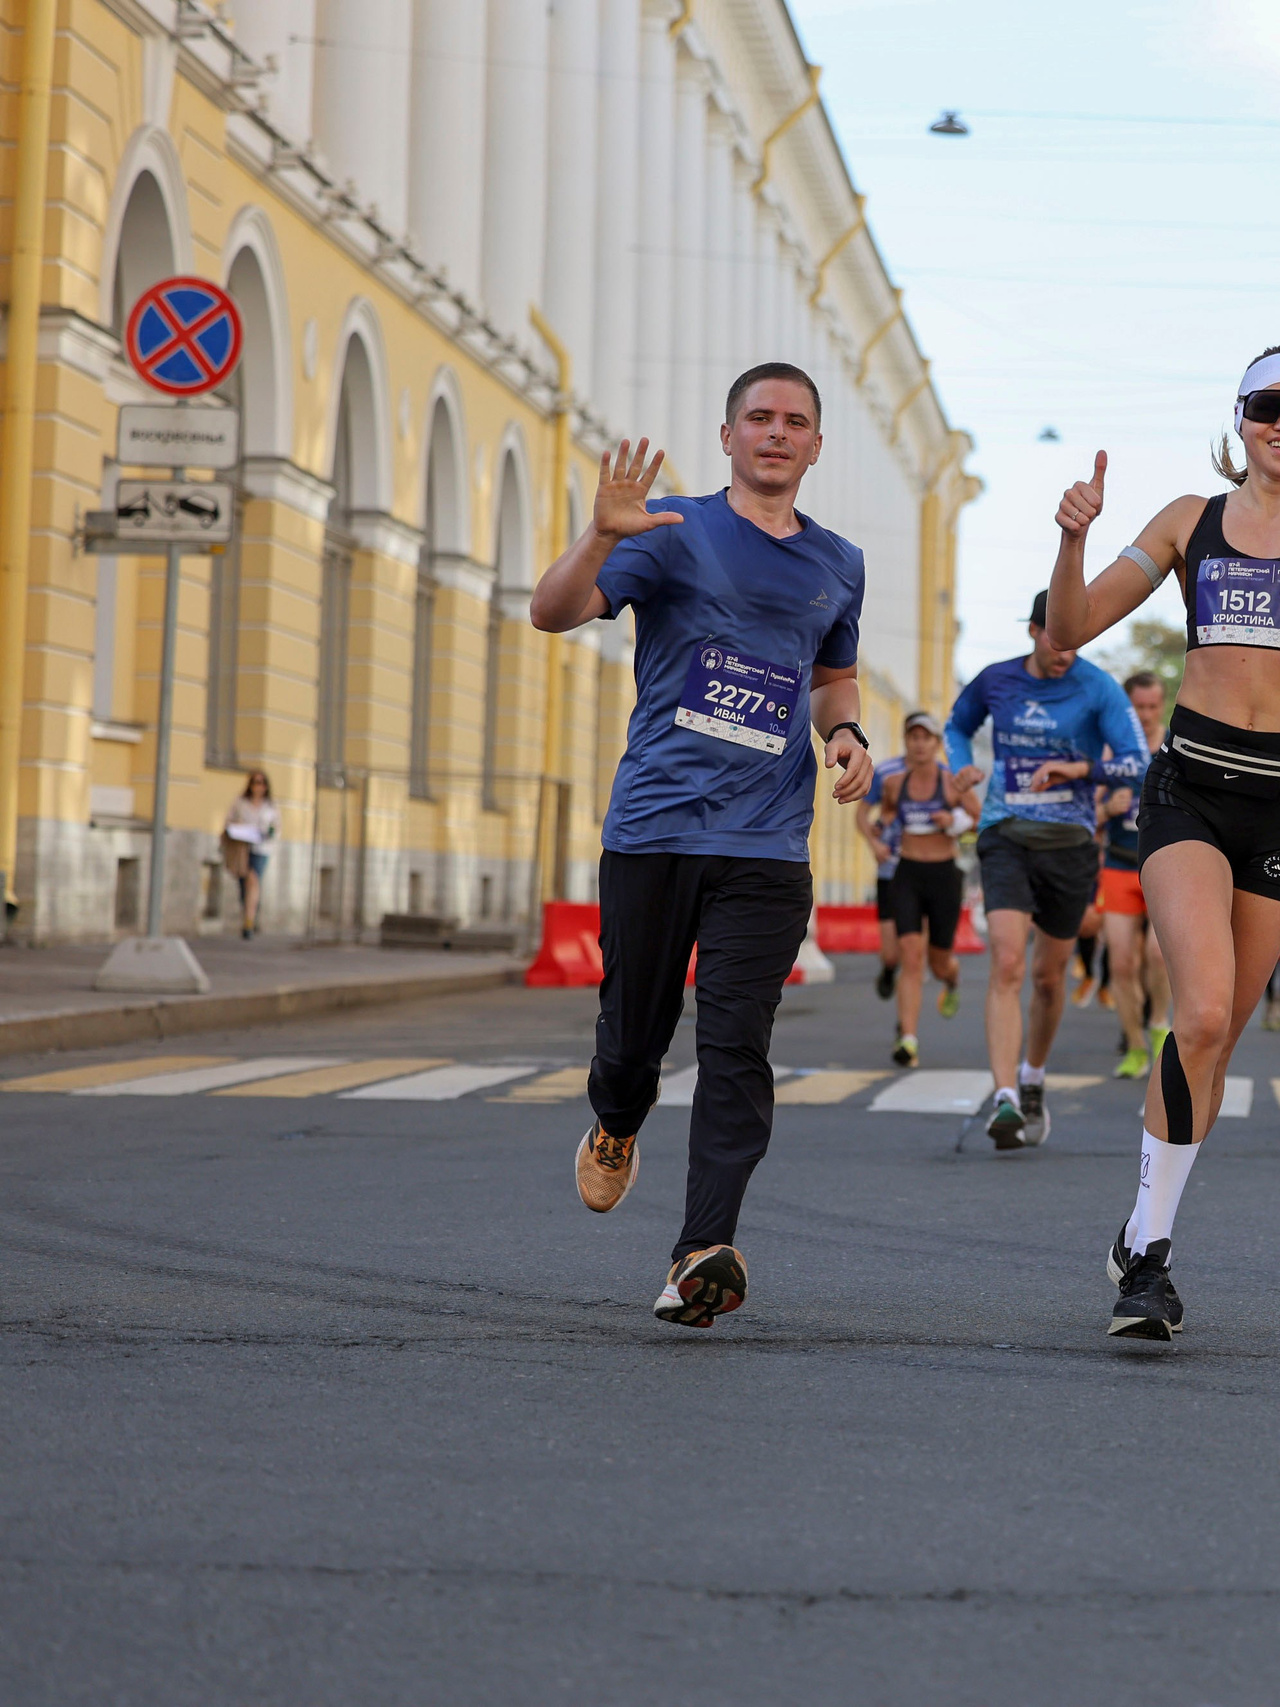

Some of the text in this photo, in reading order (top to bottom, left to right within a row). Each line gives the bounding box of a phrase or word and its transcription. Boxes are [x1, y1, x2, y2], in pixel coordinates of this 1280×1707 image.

[1220, 590, 1271, 613] 1512
[1212, 614, 1274, 626] КРИСТИНА
[704, 680, 766, 714] 2277
[713, 706, 746, 724] ИВАН
